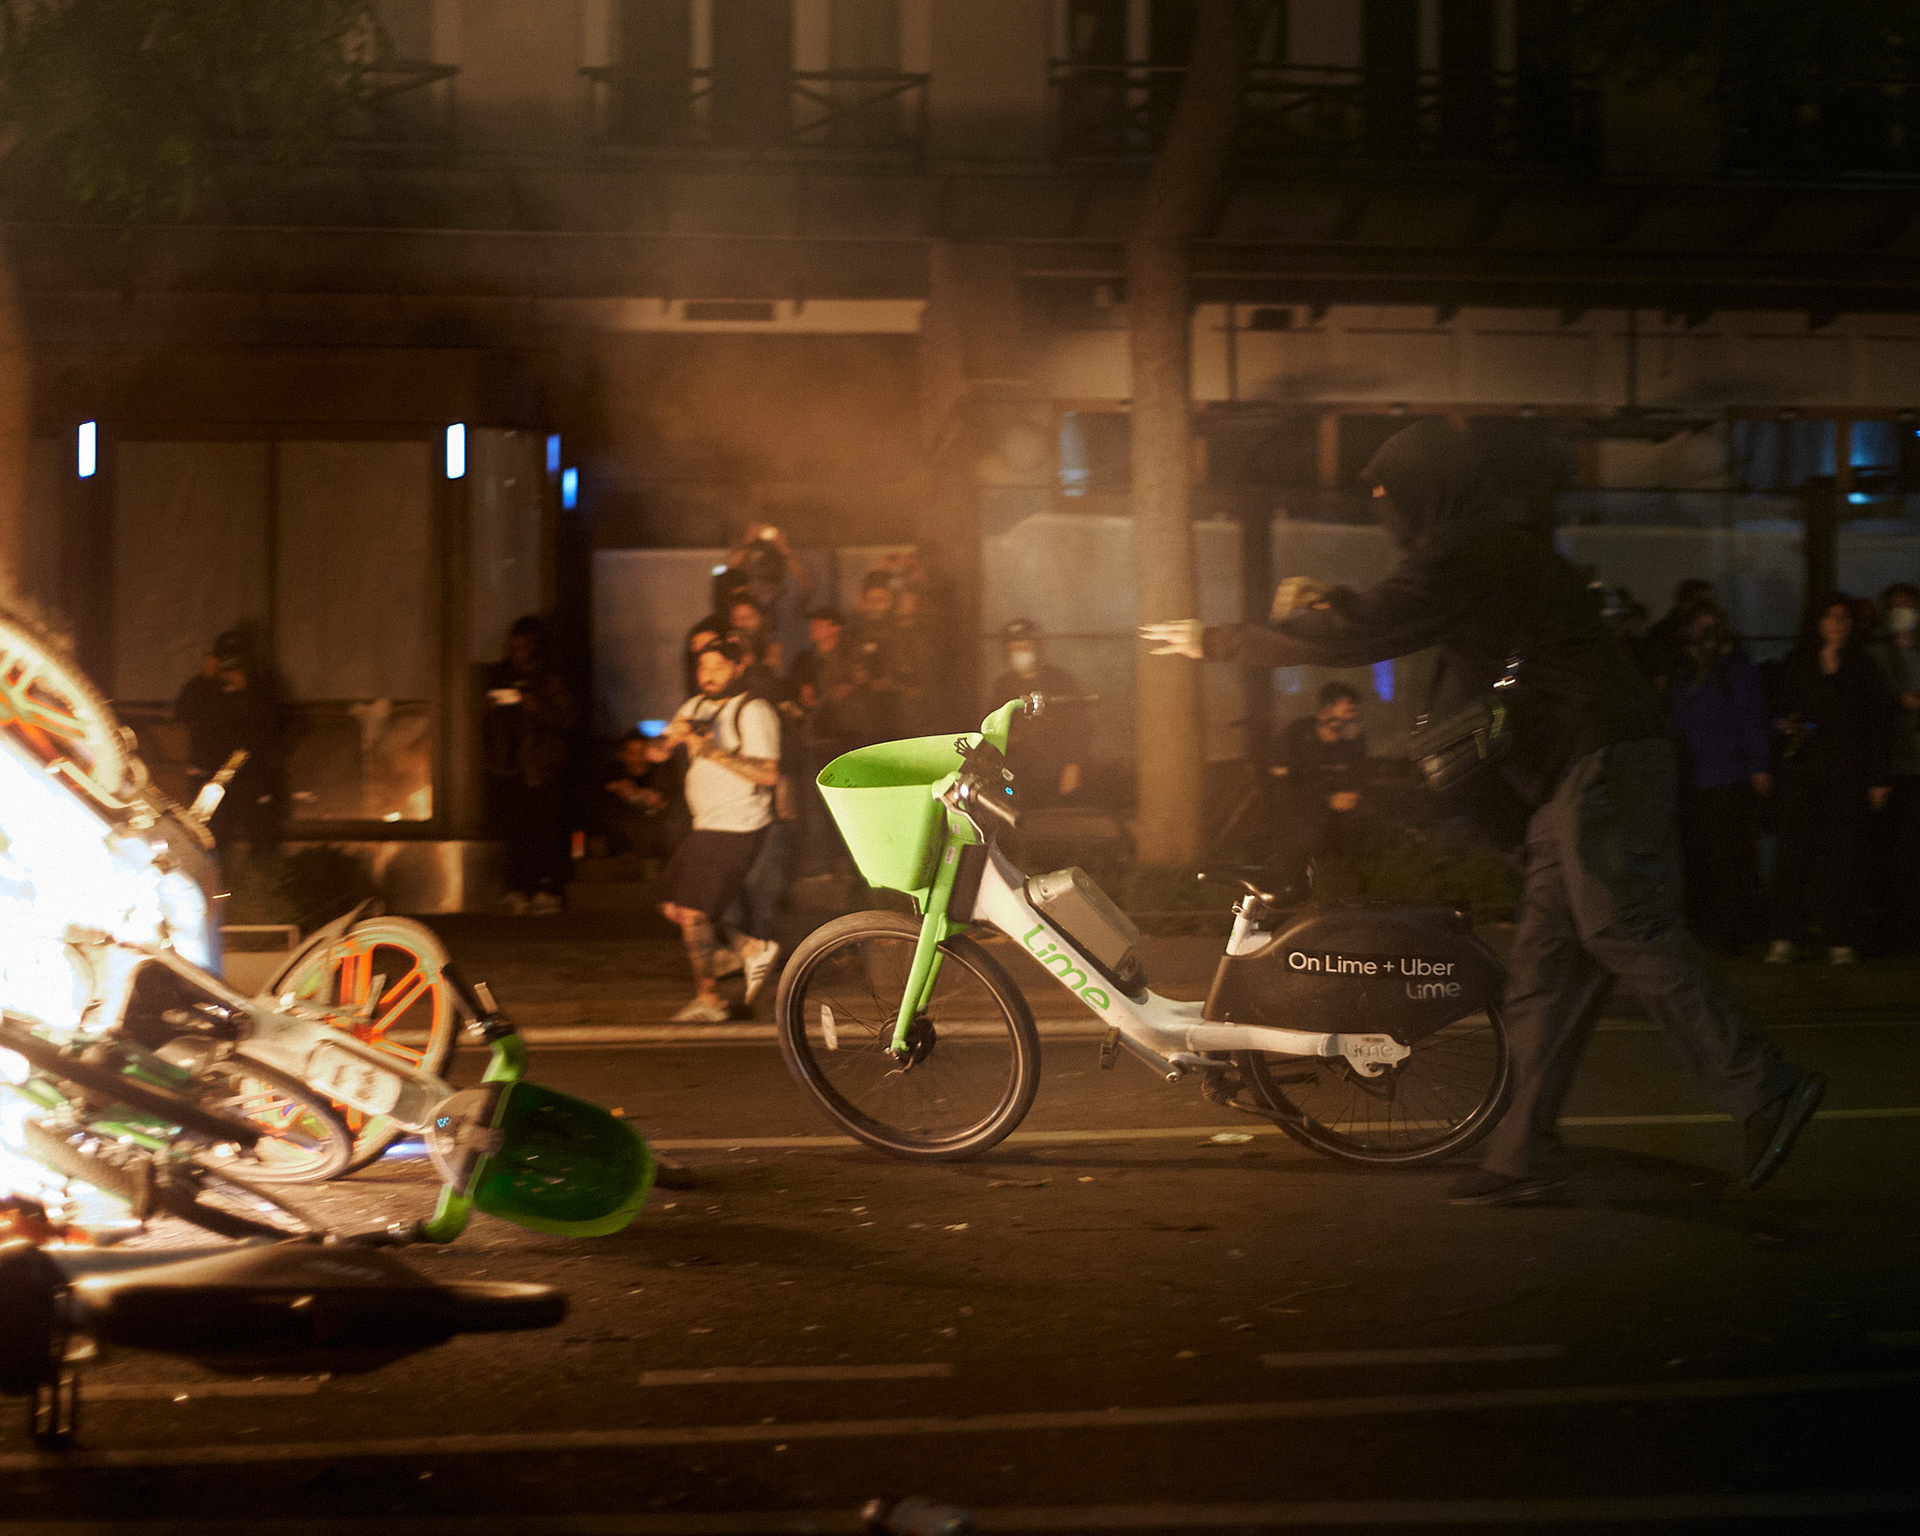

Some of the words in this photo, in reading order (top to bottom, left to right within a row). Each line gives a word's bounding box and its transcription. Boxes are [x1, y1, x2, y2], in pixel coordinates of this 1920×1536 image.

[1023, 923, 1110, 1011] Lime
[1288, 951, 1320, 971] On
[1325, 955, 1378, 975] Lime
[1383, 961, 1395, 972] +
[1400, 958, 1455, 976] Uber
[1405, 981, 1462, 1000] Lime
